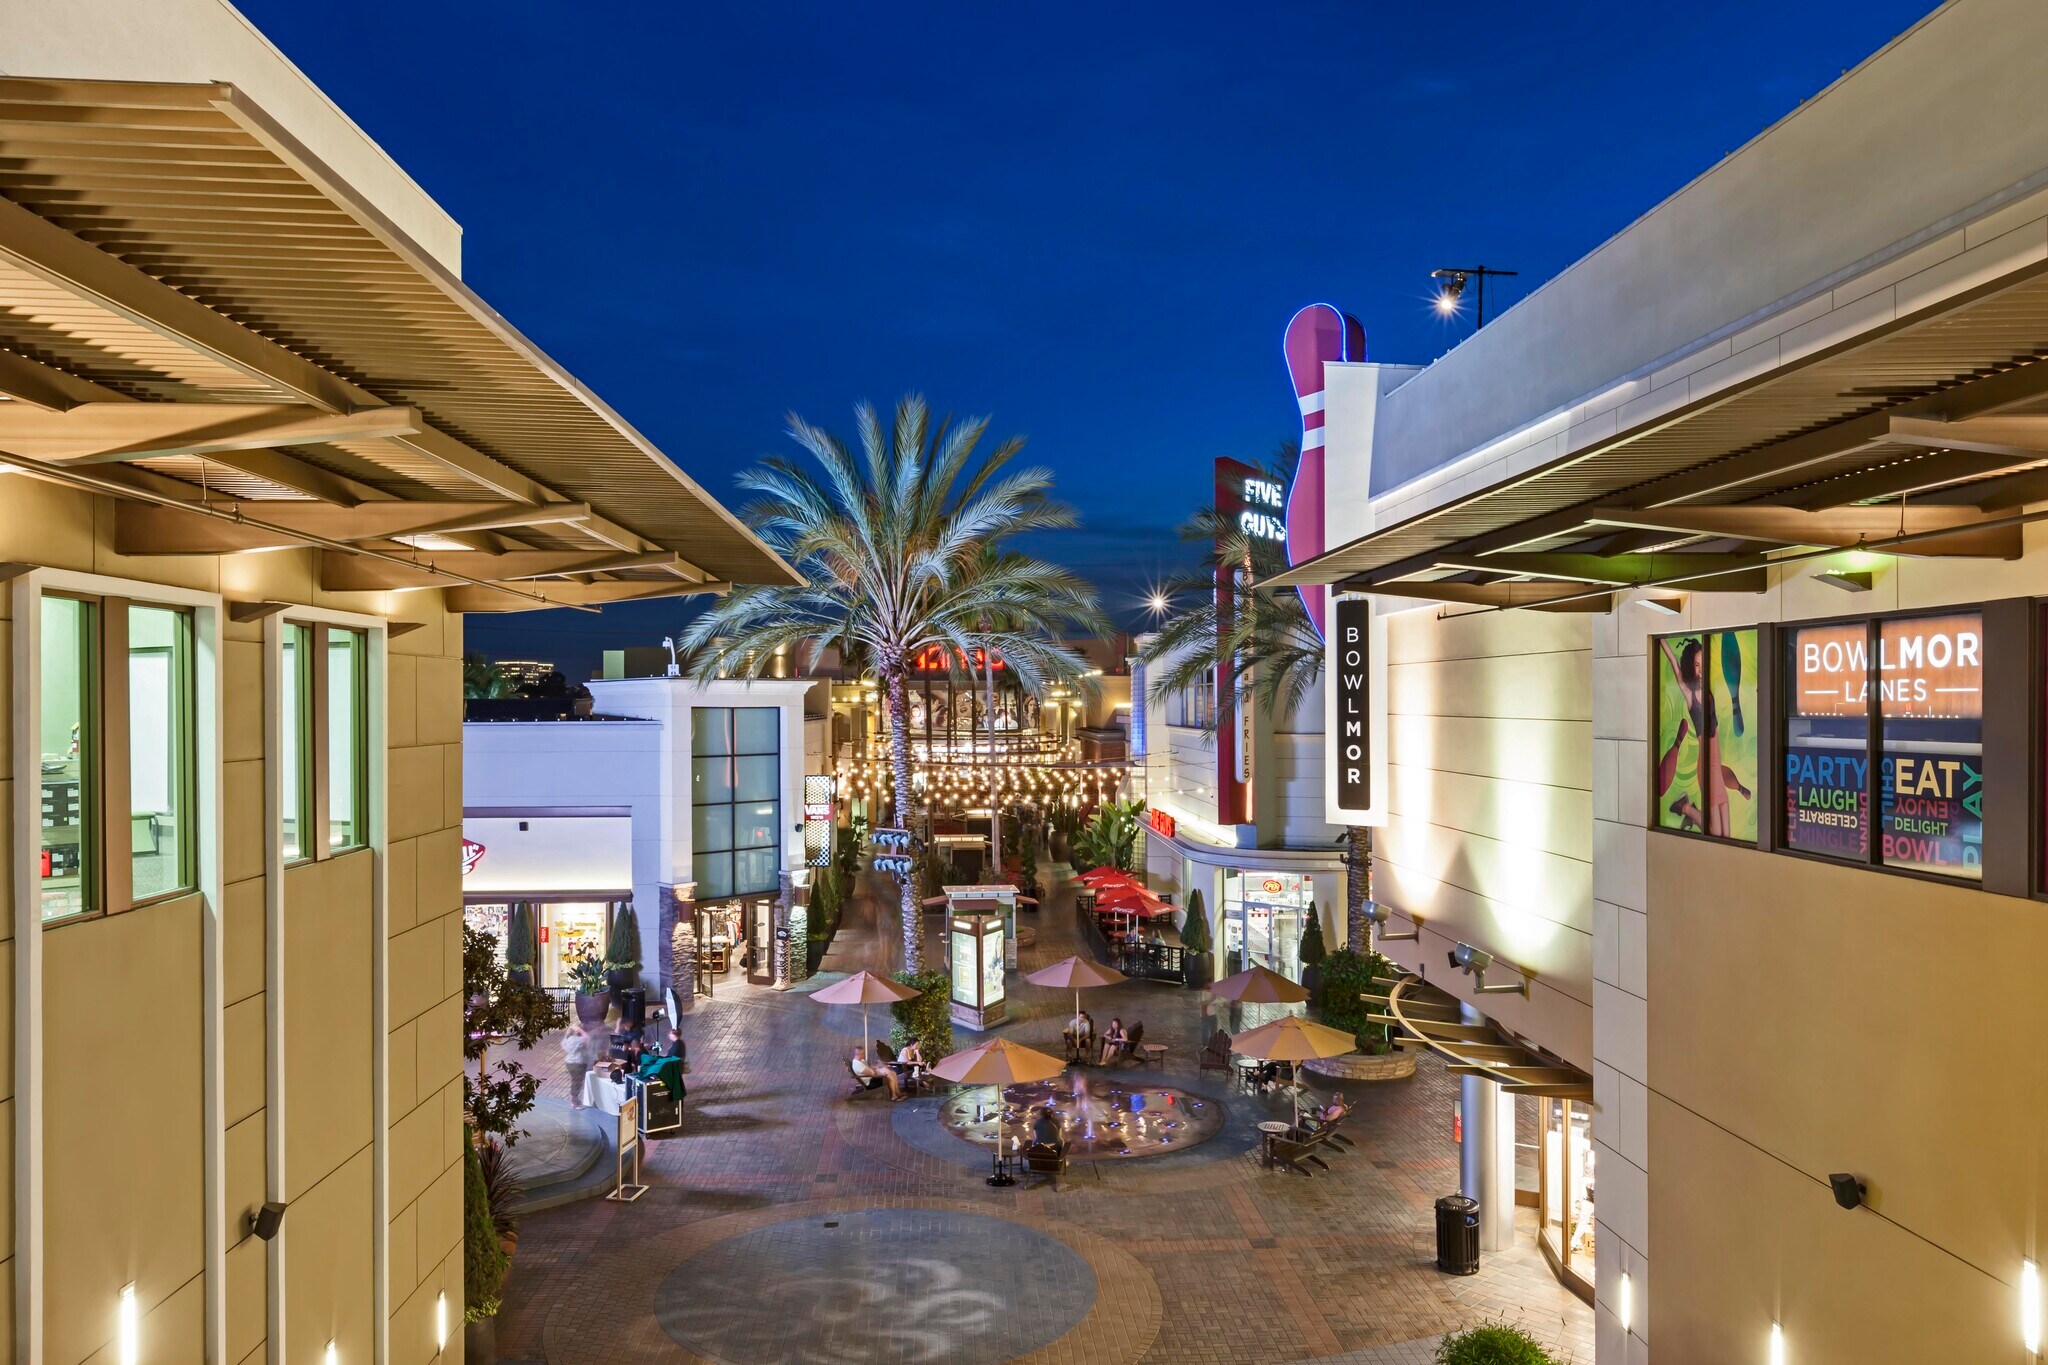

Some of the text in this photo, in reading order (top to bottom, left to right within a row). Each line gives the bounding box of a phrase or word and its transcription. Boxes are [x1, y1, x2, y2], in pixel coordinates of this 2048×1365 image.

[1244, 479, 1283, 508] FIVE
[1240, 511, 1287, 541] GUYS
[1804, 632, 1980, 673] BOWLMOR
[1343, 626, 1364, 785] BOWLMOR
[1844, 678, 1928, 703] LANES
[1243, 716, 1251, 779] FRIES
[1787, 753, 1868, 789] PARTY
[1895, 758, 1961, 799] EAT
[1798, 786, 1858, 812] LAUGH
[1881, 757, 1894, 829] CHILL
[1895, 797, 1949, 820] ENJOY
[804, 804, 830, 816] VANS
[1787, 785, 1797, 843] FLIRT
[1798, 809, 1858, 829] CELEBRATE
[1859, 792, 1868, 855] DRINK
[1894, 816, 1949, 837] DELIGHT
[1962, 761, 1983, 871] PLAY
[1799, 826, 1859, 851] MINGLE
[1882, 833, 1948, 866] BOWL
